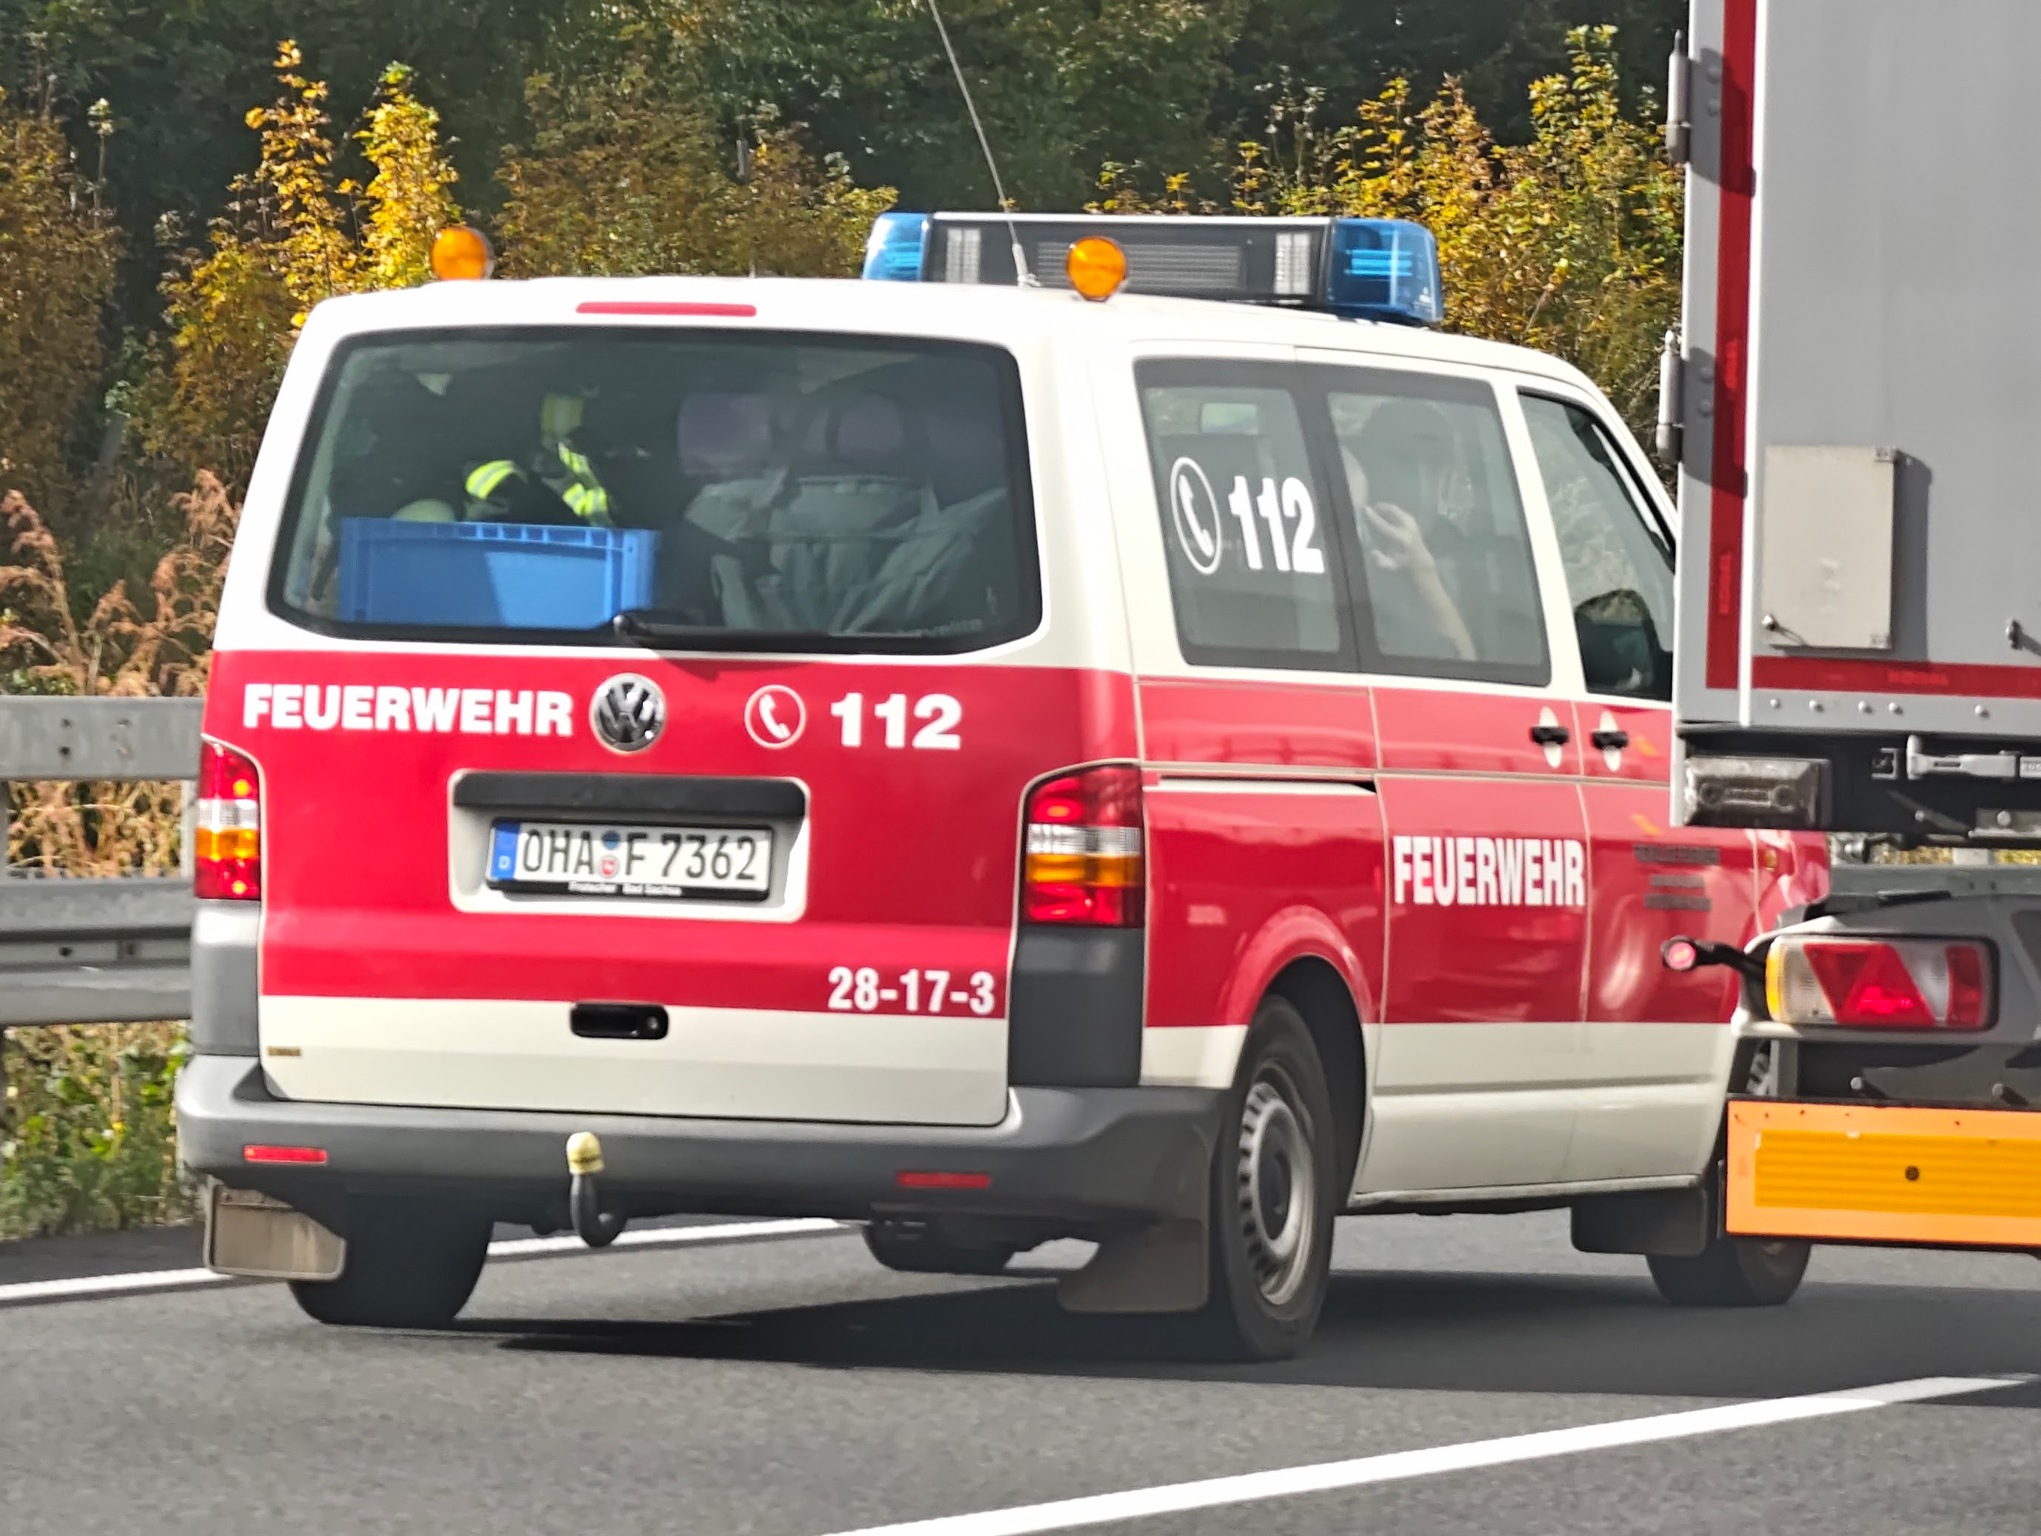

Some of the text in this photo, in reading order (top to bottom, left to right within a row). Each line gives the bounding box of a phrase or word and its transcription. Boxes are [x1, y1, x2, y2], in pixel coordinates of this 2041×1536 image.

[1228, 475, 1325, 573] 112
[243, 683, 573, 736] FEUERWEHR
[830, 692, 963, 751] 112
[522, 829, 595, 875] OHA
[625, 832, 648, 876] F
[660, 833, 757, 880] 7362
[1393, 835, 1586, 907] FEUERWEHR
[828, 966, 995, 1016] 28-17-3
